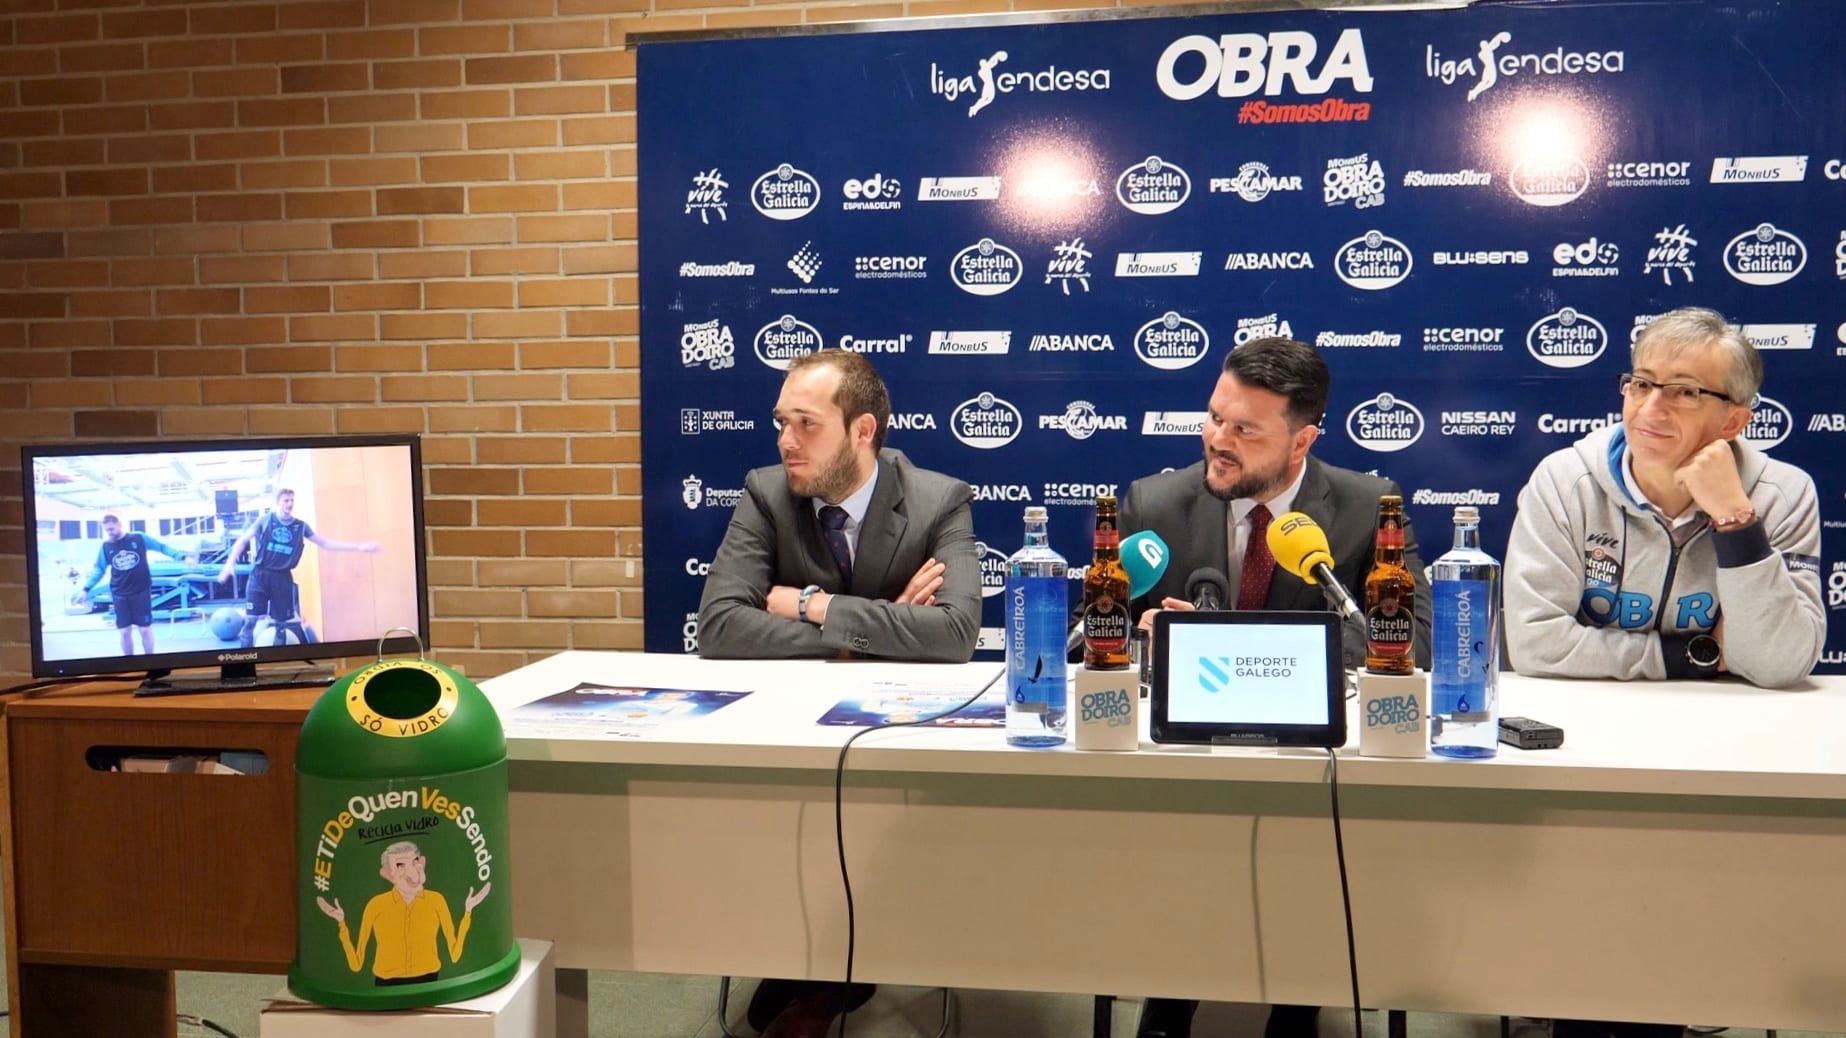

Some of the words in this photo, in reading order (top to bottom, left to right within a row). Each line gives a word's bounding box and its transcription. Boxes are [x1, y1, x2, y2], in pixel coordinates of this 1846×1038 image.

[1157, 28, 1374, 100] OBRA
[1426, 45, 1476, 85] liga
[1499, 46, 1624, 77] endesa
[931, 62, 976, 101] liga
[997, 66, 1110, 92] endesa
[1237, 97, 1371, 124] #SomosObra
[1127, 172, 1181, 189] Estrella
[1323, 160, 1385, 187] OBRA
[1403, 169, 1492, 188] #SomosObra
[760, 178, 811, 194] Estrella
[1209, 176, 1303, 193] PESCAMAR
[1607, 177, 1691, 187] electrodomésticos
[1129, 187, 1179, 204] Galicia
[1323, 178, 1386, 203] DOIRO
[763, 193, 809, 209] Galicia
[1346, 247, 1402, 263] Estrella
[1735, 241, 1797, 257] Estrella
[960, 253, 1013, 269] Estrella
[1737, 255, 1793, 273] Galicia
[679, 261, 756, 279] #SomosObra
[962, 268, 1011, 284] Galicia
[1348, 261, 1400, 278] Galicia
[681, 325, 734, 351] OBRA
[763, 330, 814, 346] Estrella
[1144, 327, 1199, 344] Estrella
[1315, 330, 1402, 348] #SomosObra
[1538, 325, 1597, 341] Estrella
[681, 342, 735, 365] DOIRO
[765, 344, 812, 359] Galicia
[1146, 342, 1197, 359] Galicia
[1423, 342, 1504, 353] electrodomésticos
[1540, 340, 1594, 356] Galicia
[702, 411, 735, 420] XUNTA
[960, 407, 1013, 423] Estrella
[1039, 414, 1127, 431] PESCAMAR
[1357, 411, 1414, 427] Estrella
[1442, 411, 1516, 424] NISSAN
[702, 420, 714, 430] DE
[715, 420, 755, 430] GALICIA
[962, 421, 1010, 438] Galicia
[1360, 424, 1411, 441] Galicia
[1442, 424, 1485, 436] CAEIRO
[1490, 424, 1515, 436] REY
[705, 498, 722, 507] DA
[1412, 488, 1501, 505] #SomosObra
[1087, 614, 1125, 627] Estrella
[1370, 617, 1410, 630] Estrella
[1087, 625, 1123, 637] Galicia
[1370, 628, 1408, 642] Galicia
[225, 652, 258, 662] Polaroid
[1235, 656, 1298, 667] DEPORTE
[1235, 668, 1292, 678] GALEGO
[1081, 688, 1130, 709] OBRA
[1366, 694, 1419, 714] OBRA
[1082, 703, 1131, 722] DOIRO
[1367, 706, 1420, 728] DOIRO
